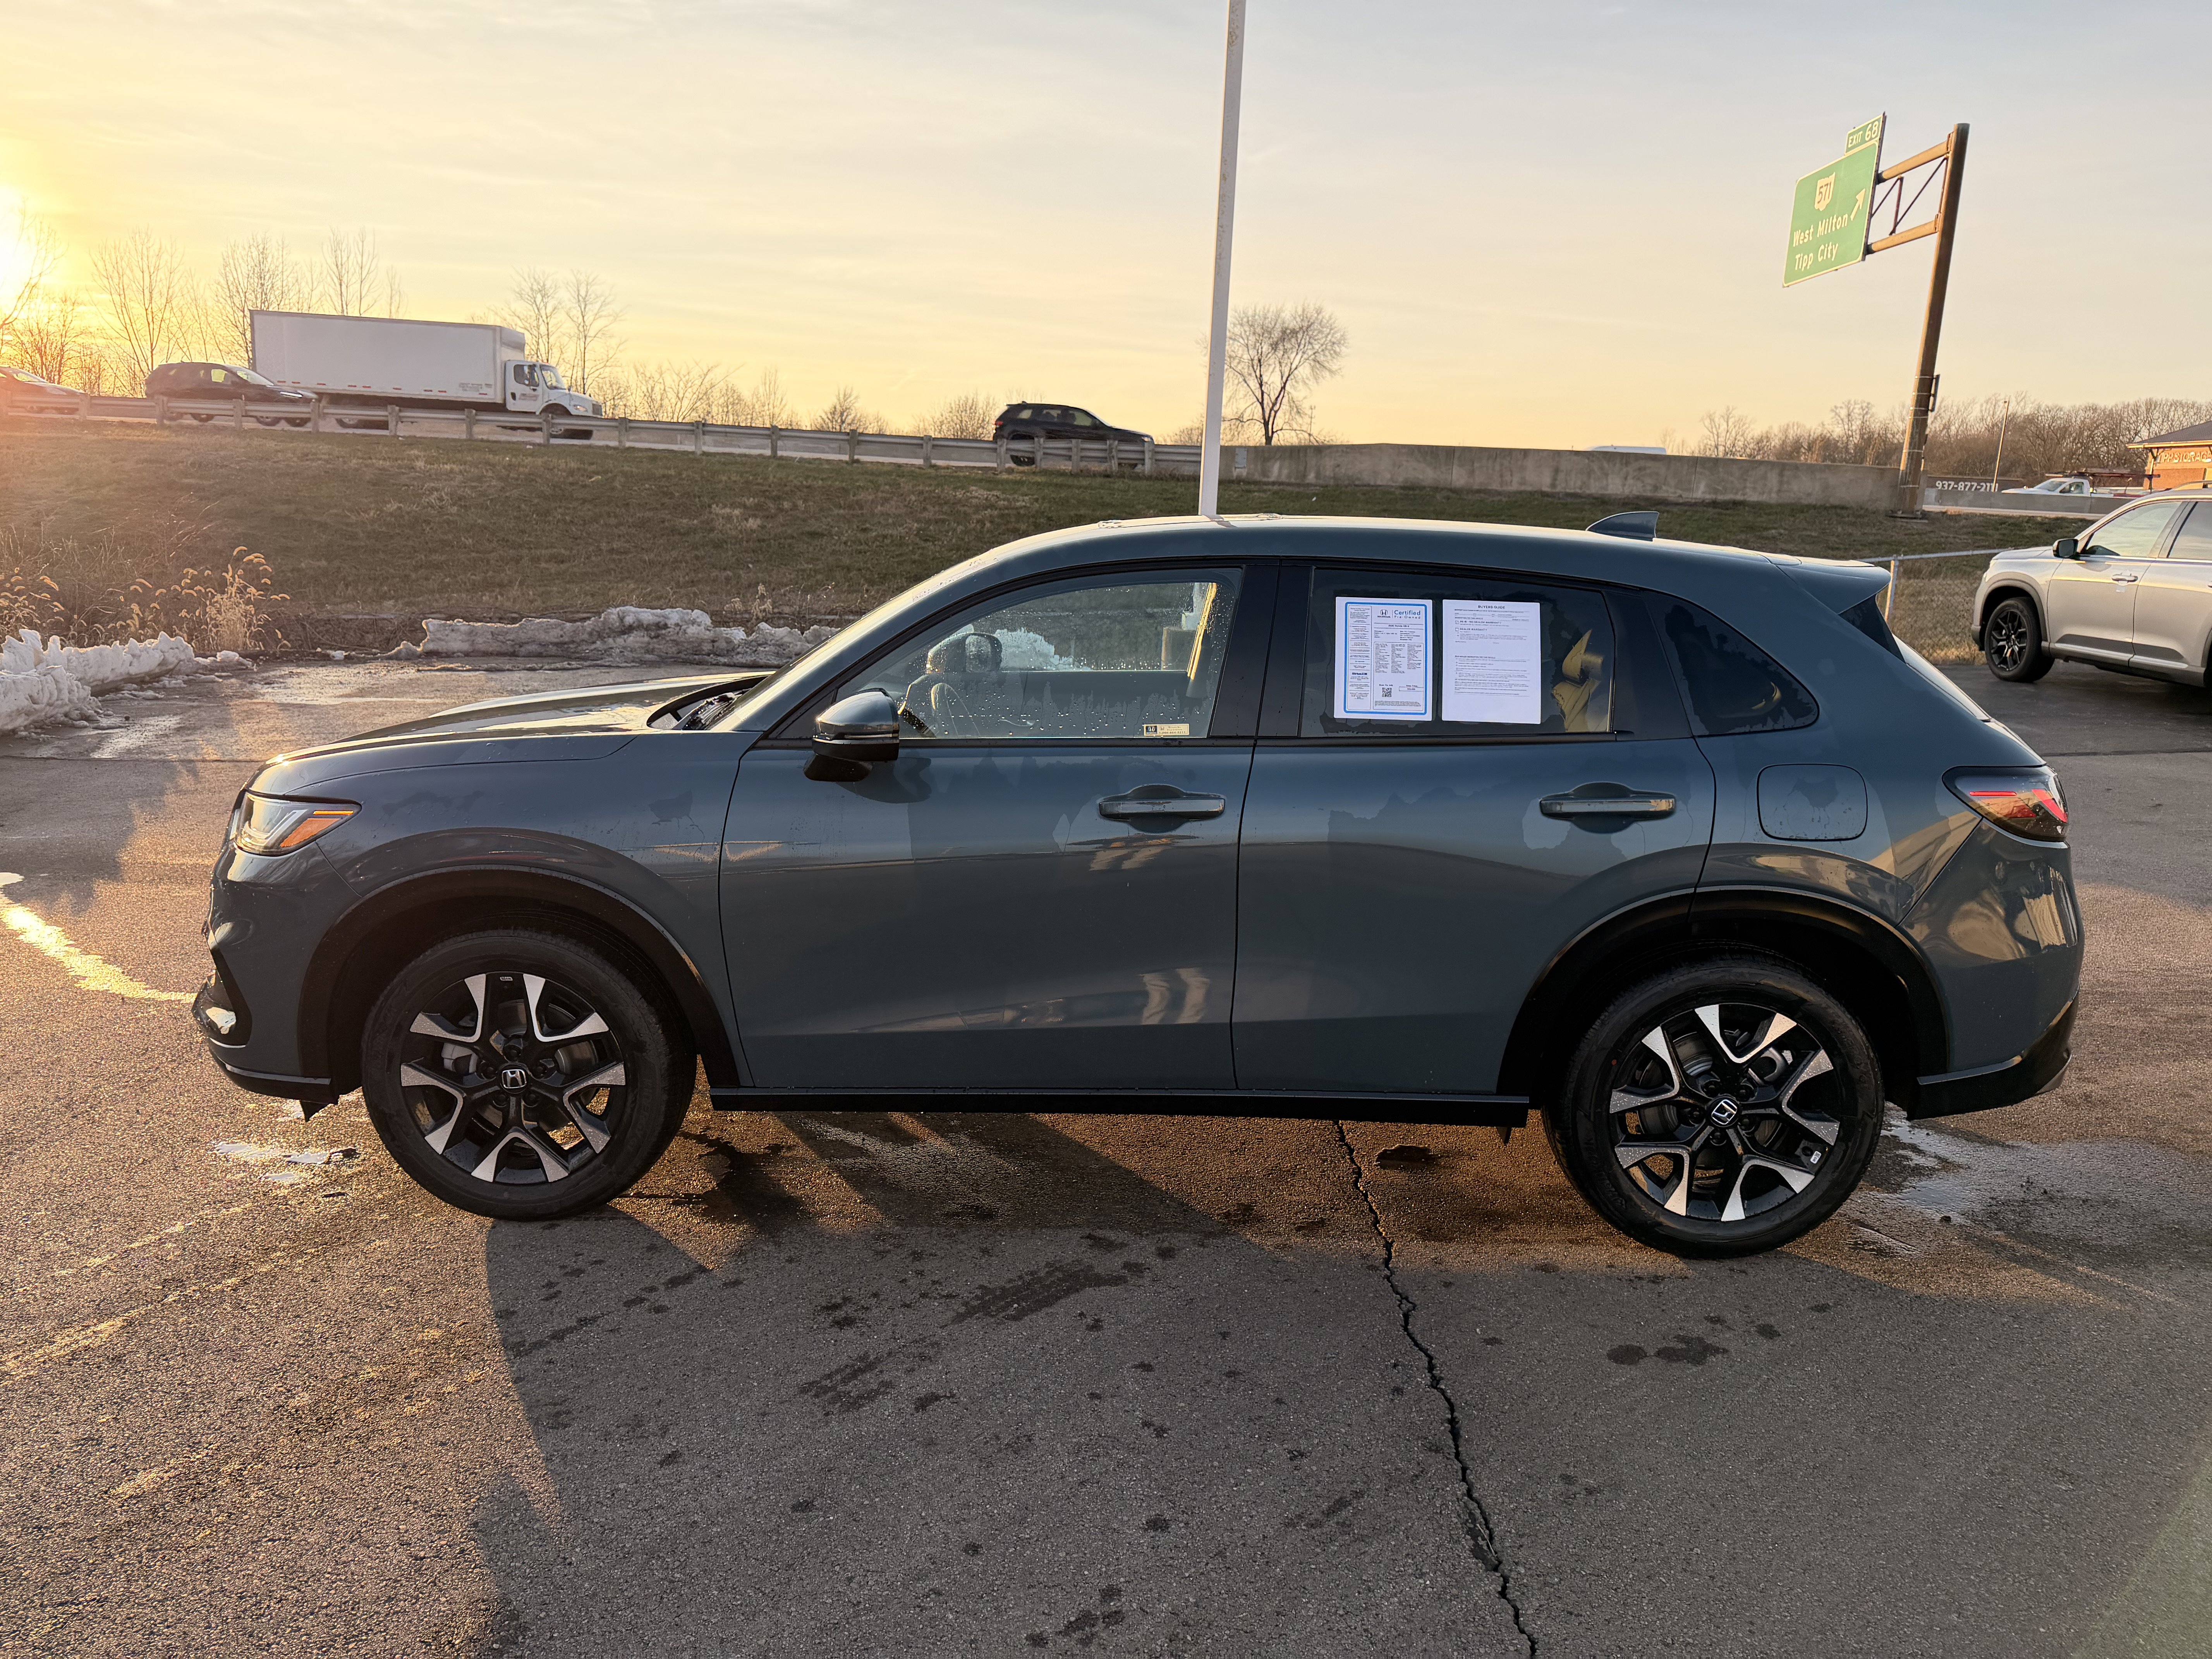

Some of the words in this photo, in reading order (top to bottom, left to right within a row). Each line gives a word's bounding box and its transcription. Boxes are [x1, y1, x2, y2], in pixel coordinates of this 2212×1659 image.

[1848, 131, 1863, 148] EXIT
[1865, 121, 1879, 141] 68
[1817, 181, 1832, 204] 571
[1793, 225, 1814, 247] West
[1817, 214, 1848, 237] Milton
[1795, 253, 1814, 271] Tipp
[1818, 242, 1839, 264] City
